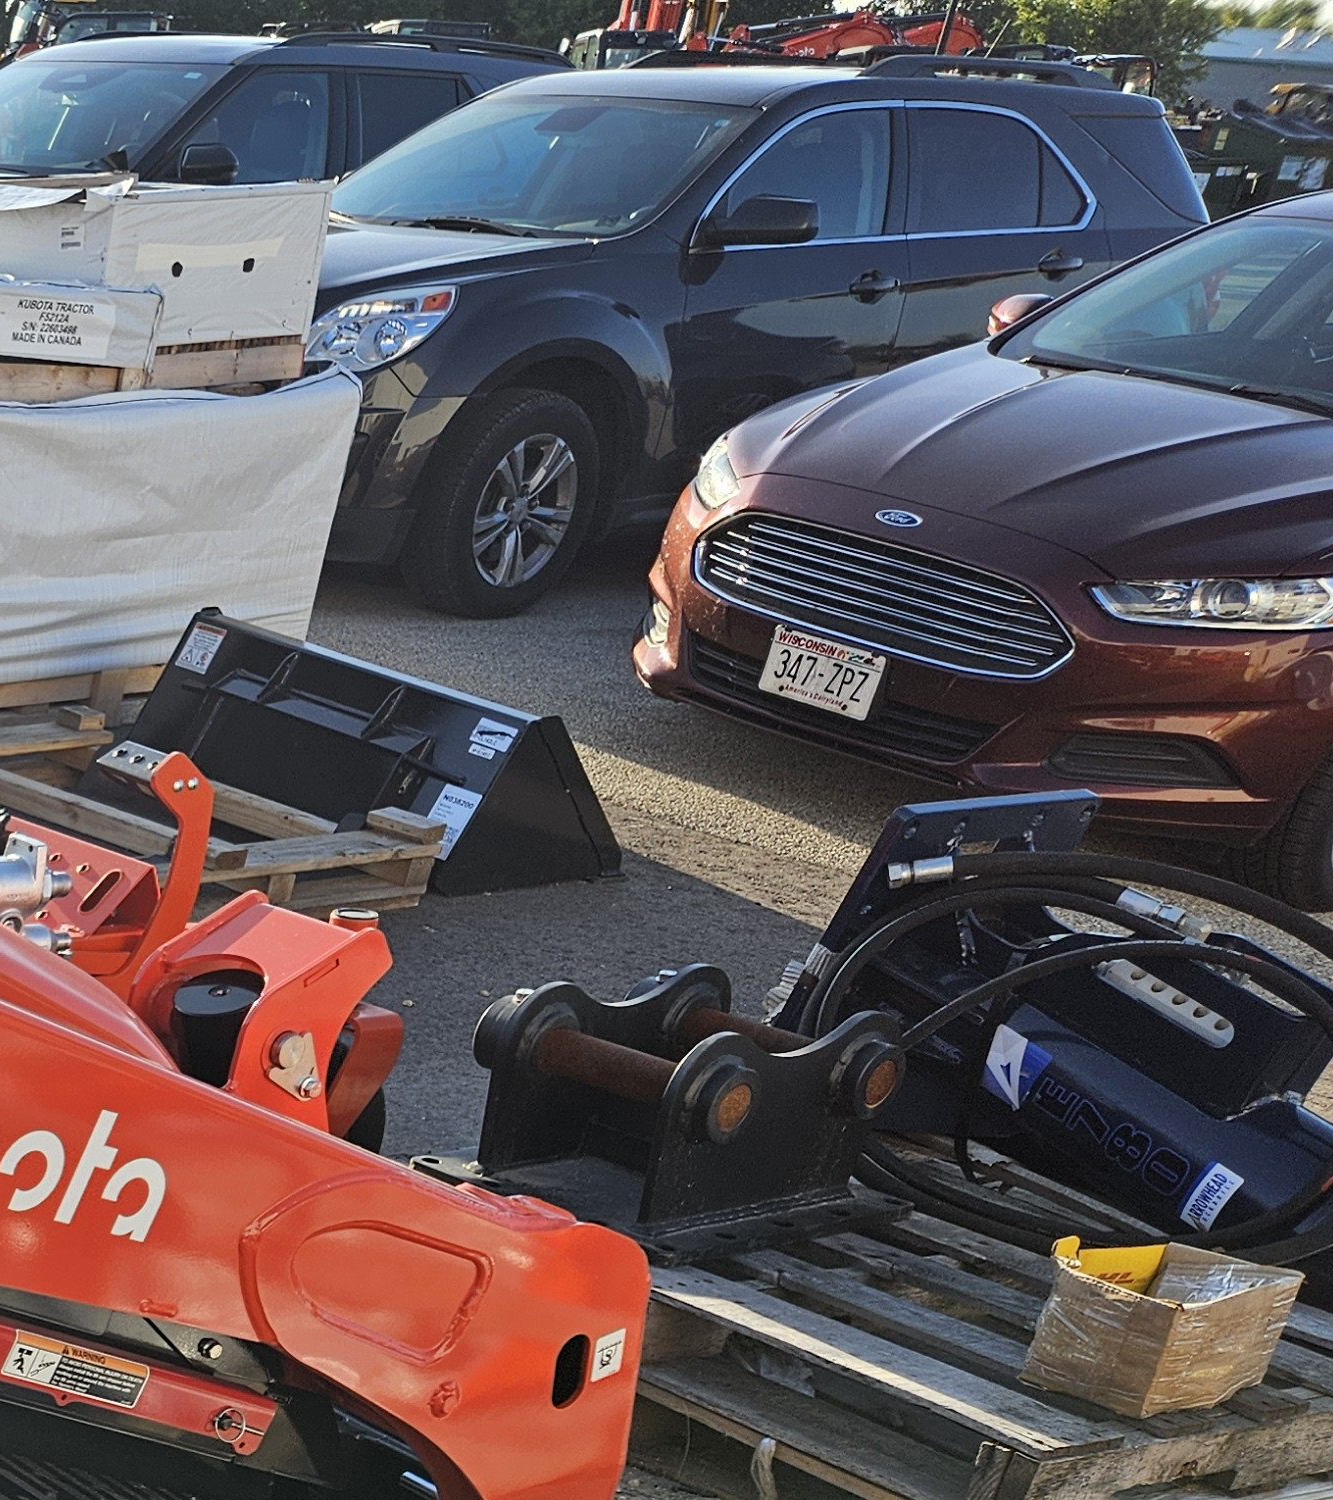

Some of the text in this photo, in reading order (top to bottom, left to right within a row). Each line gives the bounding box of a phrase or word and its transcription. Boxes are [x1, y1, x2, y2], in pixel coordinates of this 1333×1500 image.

[17, 299, 95, 315] KUBOTA TRACTOR
[11, 332, 82, 346] MADE IN CANADA
[778, 631, 837, 656] WISCONSIN
[774, 649, 870, 703] 347-ZPZ
[1034, 1077, 1190, 1197] E780
[1186, 1173, 1228, 1221] ARROWHEAD
[72, 1348, 107, 1365] WARNING
